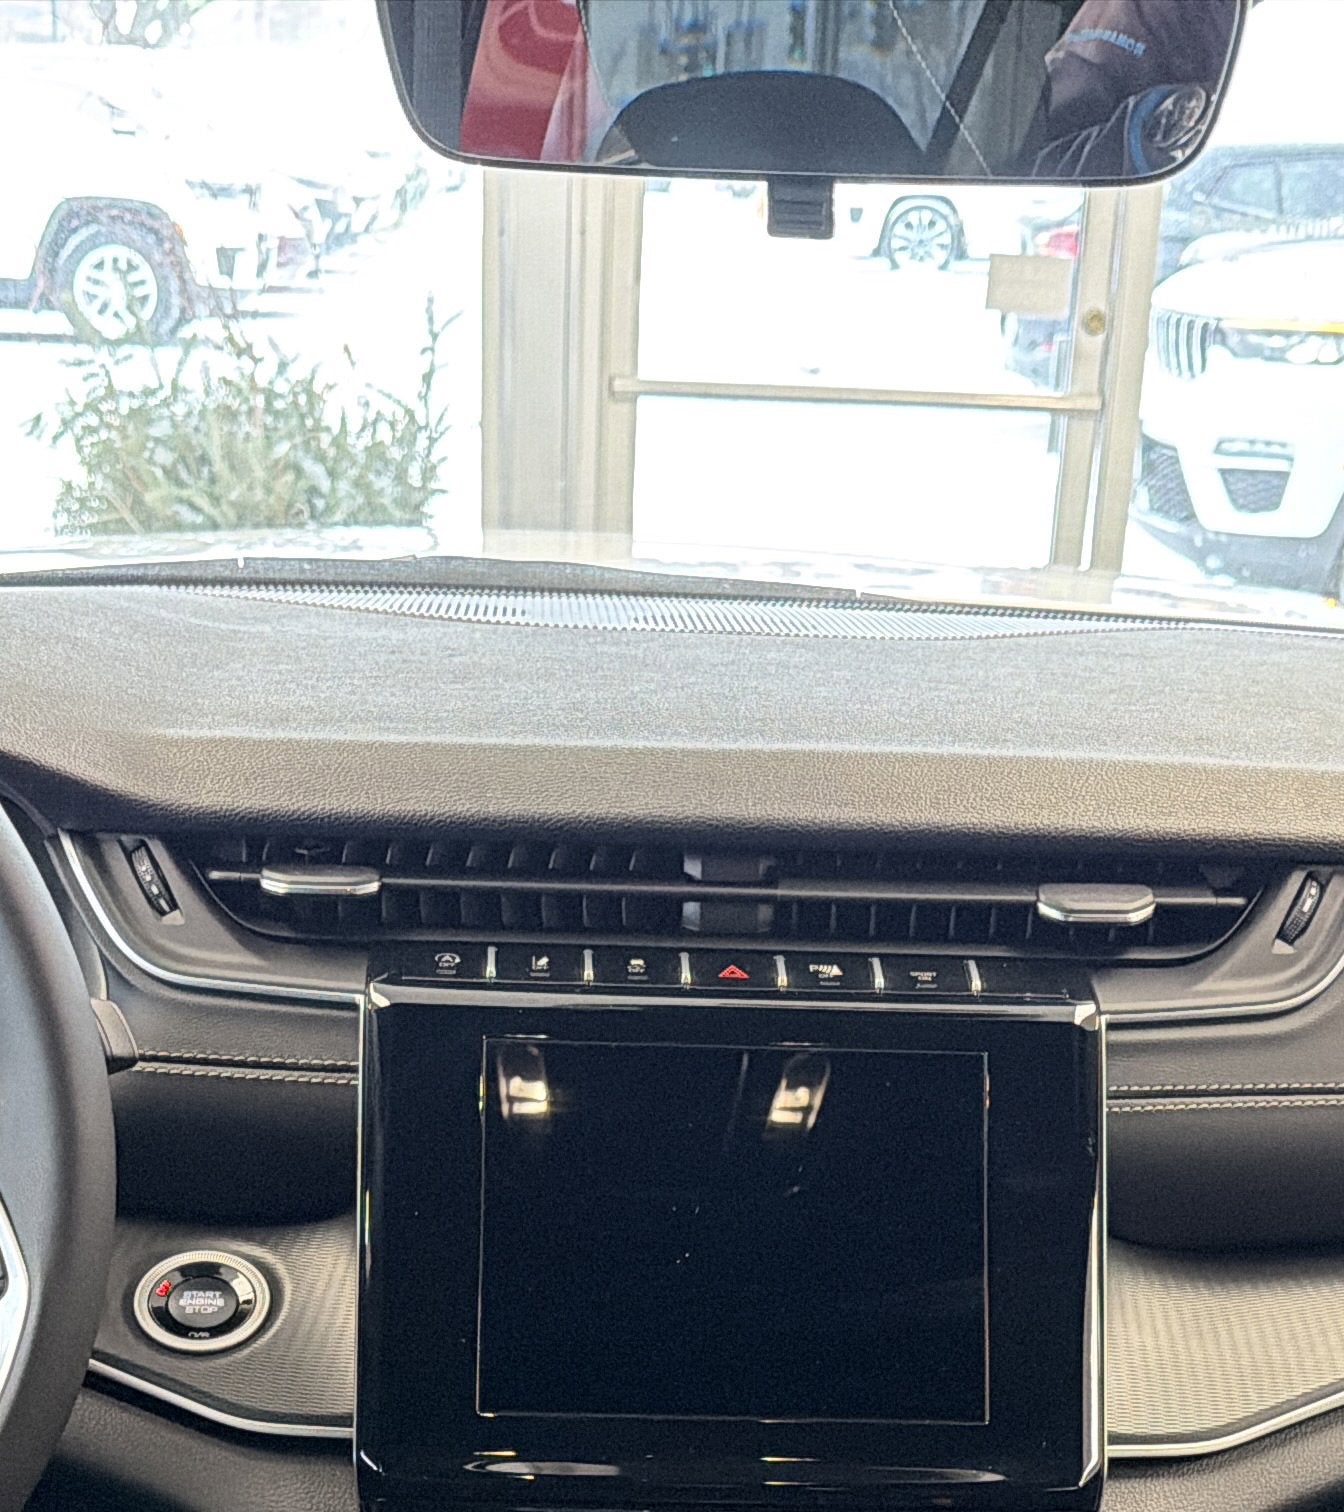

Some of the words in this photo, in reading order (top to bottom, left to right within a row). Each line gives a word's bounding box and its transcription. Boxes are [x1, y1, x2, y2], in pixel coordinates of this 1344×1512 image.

[182, 1290, 223, 1298] START
[178, 1298, 225, 1307] ENGINE
[184, 1305, 219, 1314] STOP
